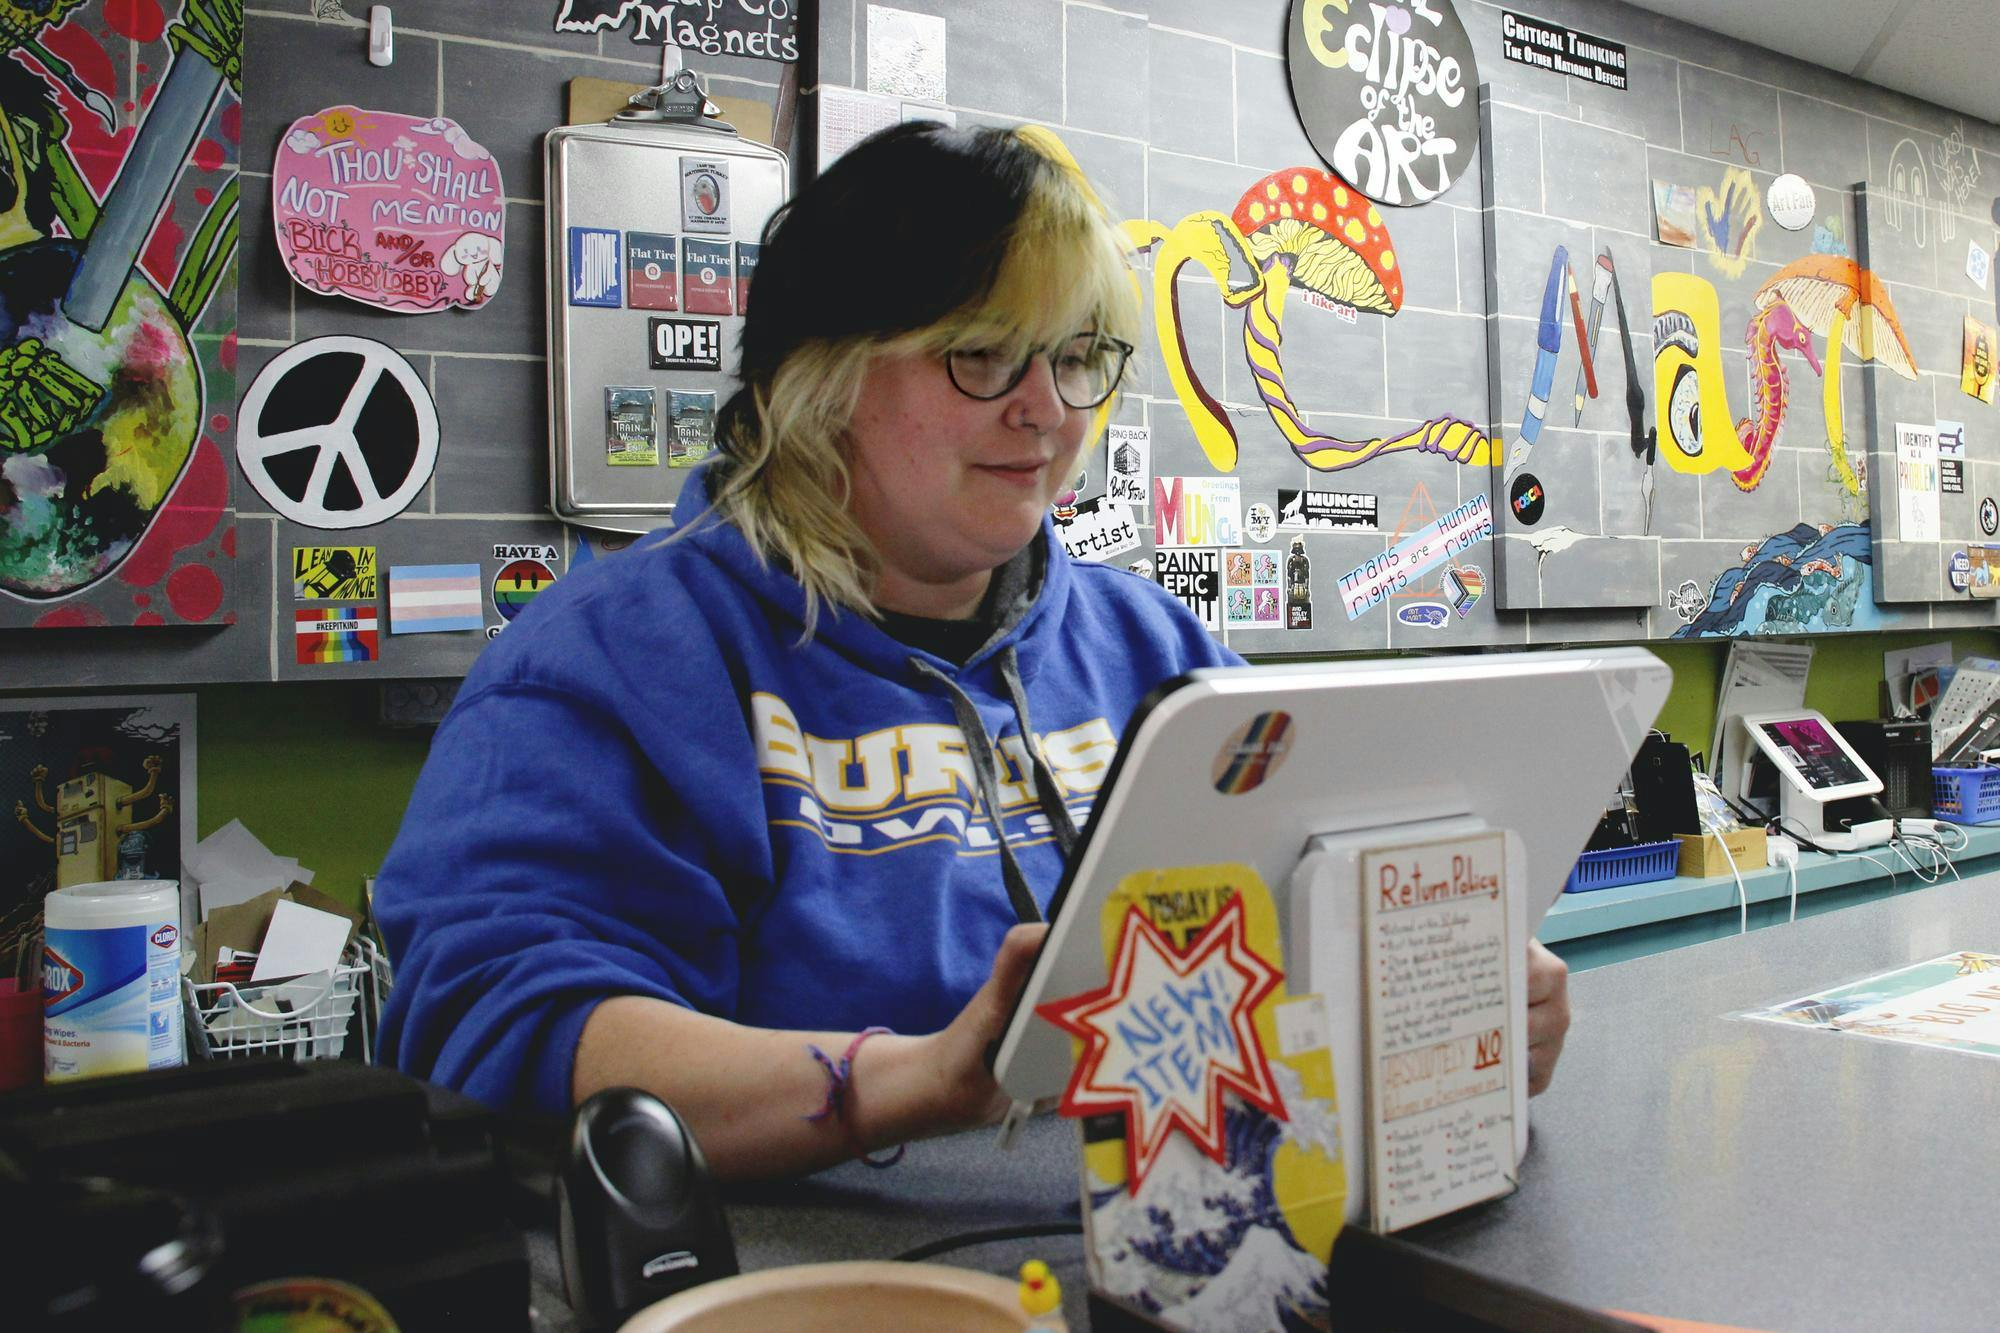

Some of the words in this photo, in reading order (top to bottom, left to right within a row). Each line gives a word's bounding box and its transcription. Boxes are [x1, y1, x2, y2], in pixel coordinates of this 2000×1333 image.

[634, 5, 799, 61] Magnets
[1303, 0, 1466, 108] Eclipse
[1360, 85, 1390, 122] of
[1391, 94, 1435, 140] the
[314, 140, 402, 185] THOU
[415, 151, 495, 203] SHALL
[1333, 118, 1457, 203] ART
[280, 175, 350, 224] NOT
[372, 199, 502, 232] MENTION
[574, 233, 617, 300] HOME
[631, 248, 650, 259] Flat
[654, 249, 675, 260] Tire
[687, 253, 707, 263] Flat
[709, 253, 730, 265] Tire
[740, 256, 758, 266] Fla
[316, 256, 383, 292] HOBBY
[383, 269, 444, 297] LOBBY
[1303, 291, 1307, 301] i
[1312, 294, 1335, 310] like
[1338, 305, 1356, 318] art
[656, 323, 719, 358] OPE!
[1110, 429, 1128, 439] BRING
[1128, 430, 1148, 441] BACK
[1903, 432, 1933, 448] IDENTIFY
[1202, 480, 1239, 490] Greetings
[1900, 461, 1936, 491] PROBLEM
[1211, 495, 1231, 503] From
[1307, 493, 1376, 508] MUNCIE
[1437, 494, 1488, 535] Human
[495, 546, 541, 558] HAVE
[545, 547, 557, 559] A
[1064, 521, 1134, 559] Artist
[1443, 518, 1492, 558] rights
[296, 548, 332, 579] LEAN
[358, 547, 374, 566] IN
[356, 566, 369, 575] TO
[1156, 552, 1216, 573] PAINT
[1339, 546, 1400, 592] Trans
[1410, 545, 1429, 564] are
[1164, 574, 1209, 595] EPIC
[1353, 570, 1408, 616] rights
[316, 621, 359, 631] #KEEPITKIND
[1379, 862, 1450, 912] Return
[1453, 854, 1499, 901] Policy
[154, 929, 177, 944] CLOROX
[1116, 966, 1232, 1057] NEW!
[1907, 1002, 1991, 1025] BIG
[62, 1039, 91, 1048] Bacteria
[1123, 1003, 1236, 1107] ITEM
[1475, 1029, 1502, 1064] NO
